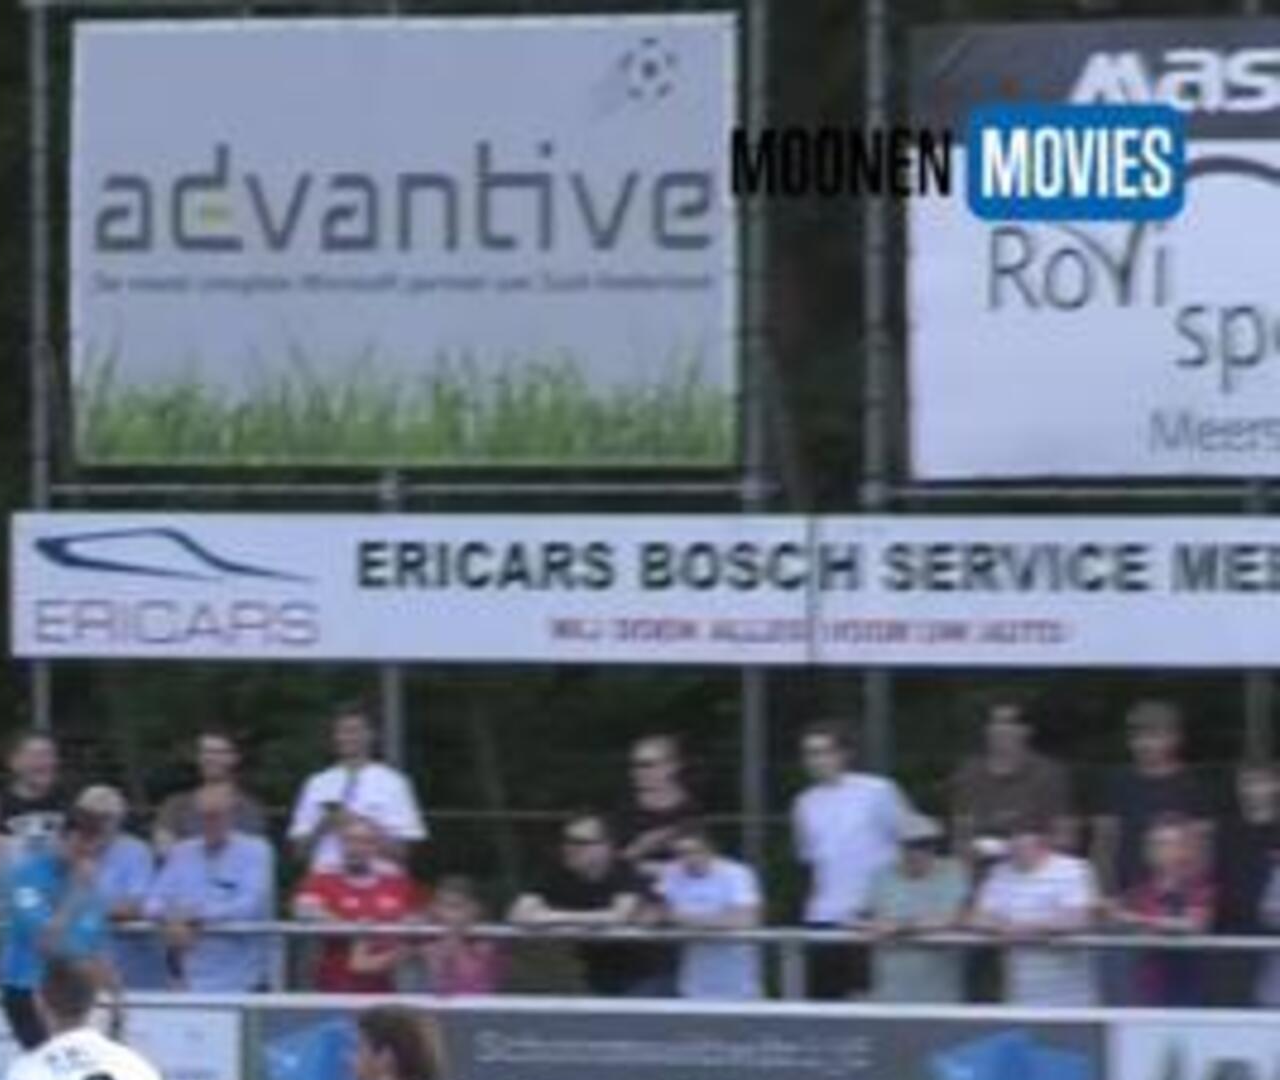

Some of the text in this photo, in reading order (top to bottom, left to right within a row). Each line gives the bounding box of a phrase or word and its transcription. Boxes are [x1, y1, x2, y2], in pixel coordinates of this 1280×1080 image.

[94, 142, 716, 252] advantive
[1173, 304, 1280, 396] sp
[356, 541, 615, 591] ERICARS
[642, 541, 857, 592] BOSCH
[881, 542, 1149, 592] SERVICE
[34, 599, 320, 646] ERICARS
